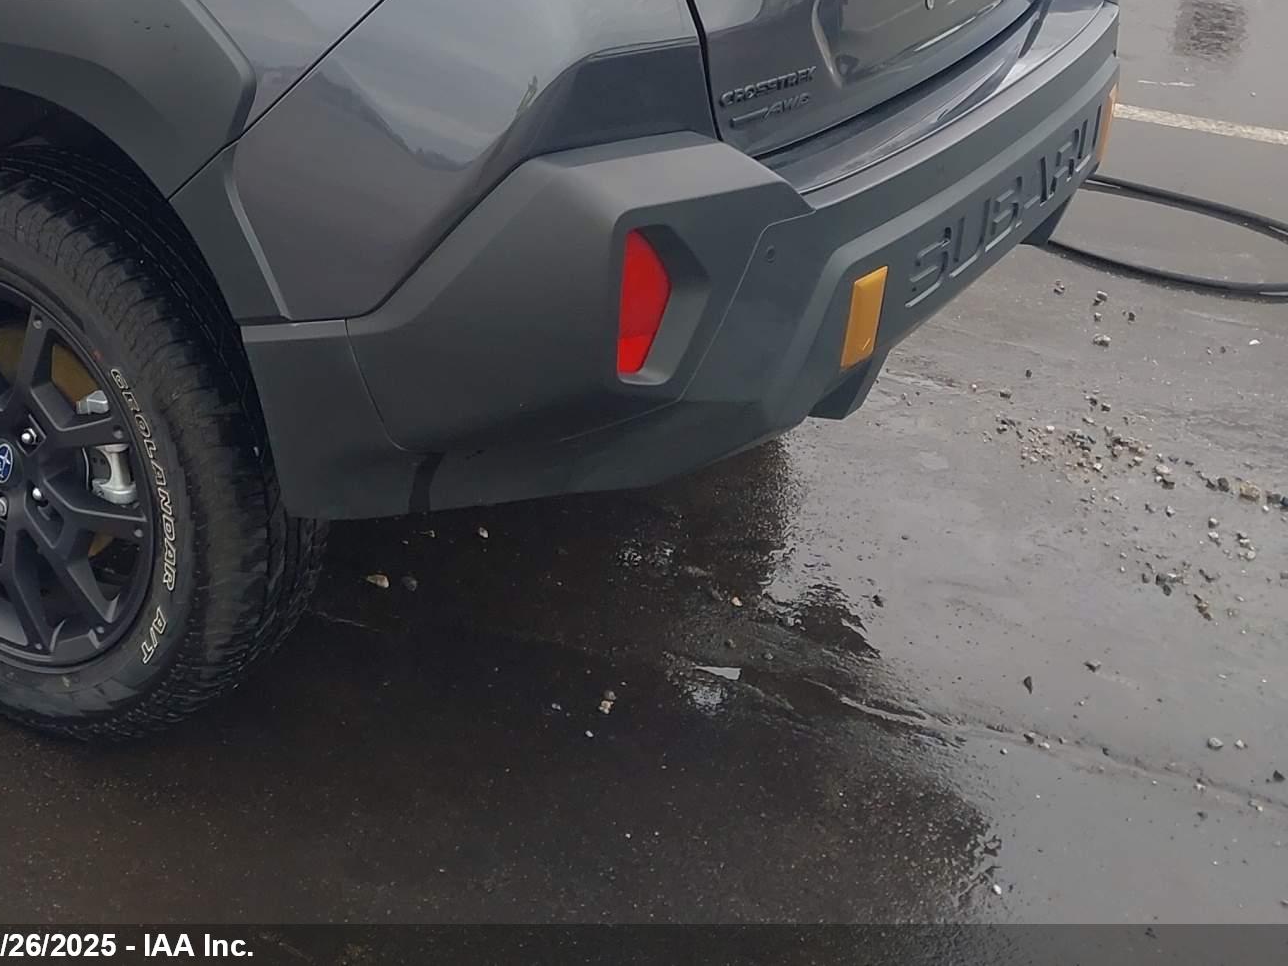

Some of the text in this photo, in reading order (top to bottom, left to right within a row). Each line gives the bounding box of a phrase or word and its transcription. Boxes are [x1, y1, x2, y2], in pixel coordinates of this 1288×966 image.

[719, 66, 817, 107] CROSSTREK
[905, 104, 1103, 308] SUBARU
[110, 368, 177, 664] GEOLANDAR A/T
